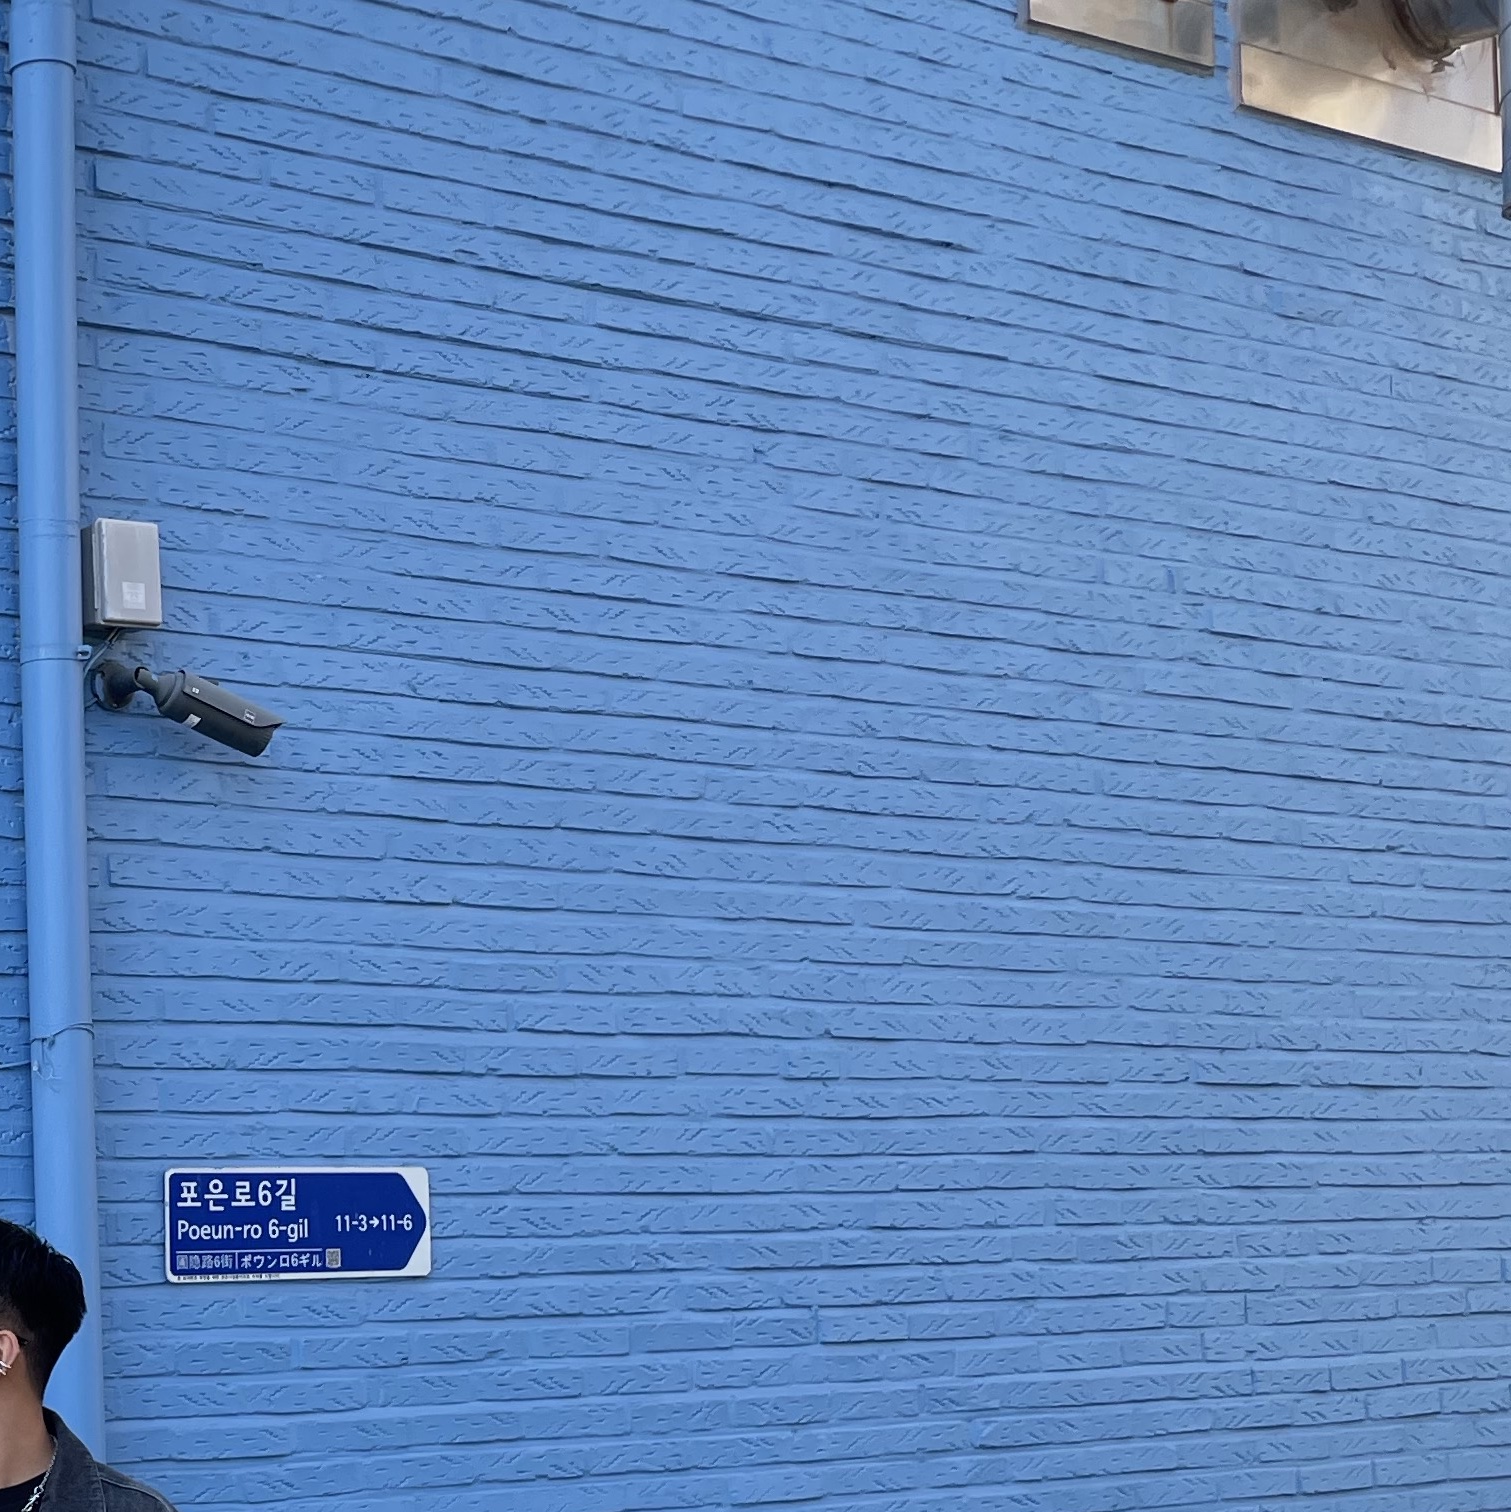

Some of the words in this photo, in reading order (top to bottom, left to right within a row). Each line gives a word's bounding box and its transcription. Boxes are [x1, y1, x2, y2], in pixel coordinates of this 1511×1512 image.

[176, 1178, 297, 1212] 포은로6길
[177, 1219, 262, 1241] Poeun-ro
[268, 1218, 309, 1243] 6-gil
